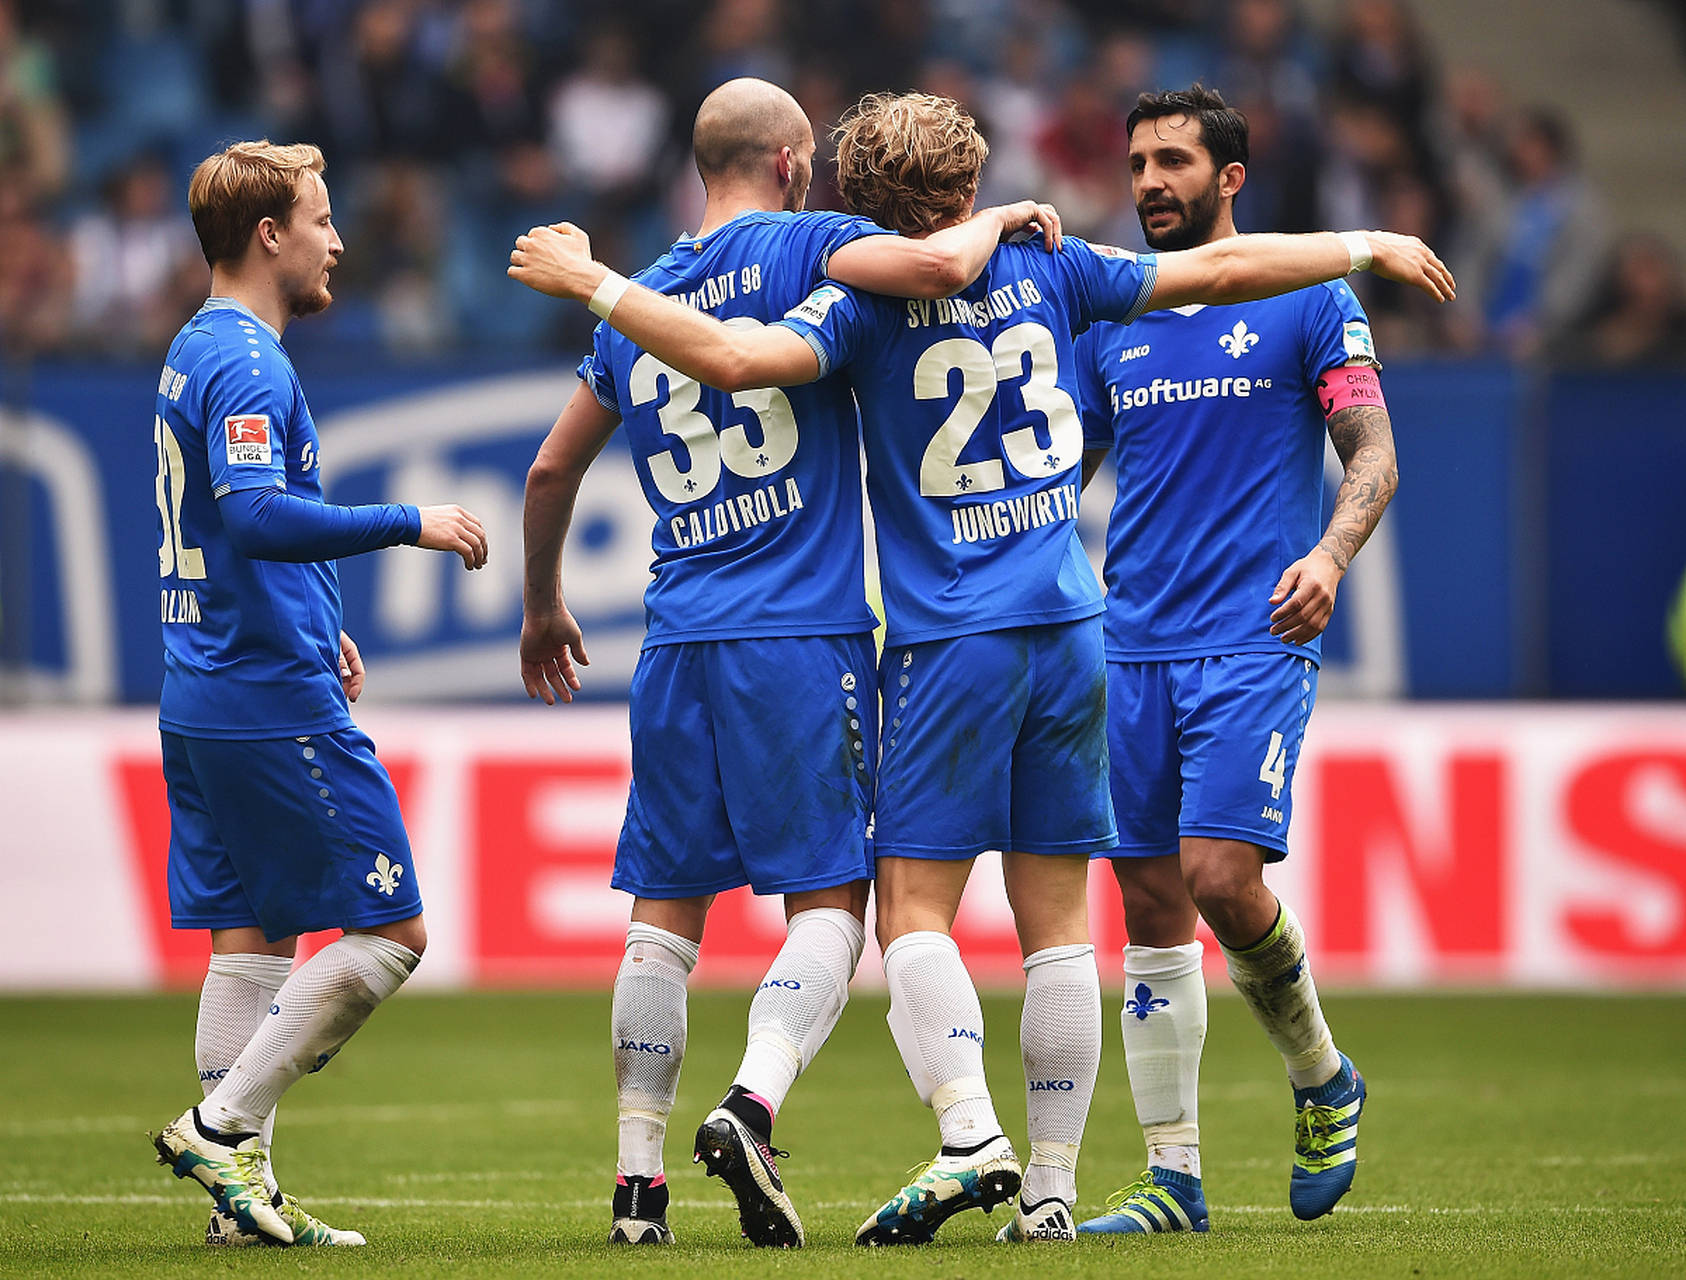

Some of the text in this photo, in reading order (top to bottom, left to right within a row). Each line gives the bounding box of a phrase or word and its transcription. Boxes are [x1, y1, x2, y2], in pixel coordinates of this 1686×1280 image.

[741, 263, 762, 294] 98
[907, 299, 930, 329] SV
[1119, 344, 1150, 363] JAKO
[1122, 377, 1272, 411] software AG
[914, 322, 1084, 497] 23
[229, 444, 269, 455] BUNDES
[236, 453, 262, 462] LIGA
[671, 478, 804, 548] CALDIROLA
[952, 484, 1078, 544] JUNGWIRTH
[1259, 730, 1287, 800] 4
[756, 978, 801, 993] AKO
[618, 1038, 671, 1055] JAKO
[198, 1068, 231, 1081] AKO
[1029, 1080, 1074, 1091] JAKO
[1031, 1228, 1074, 1241] adidas
